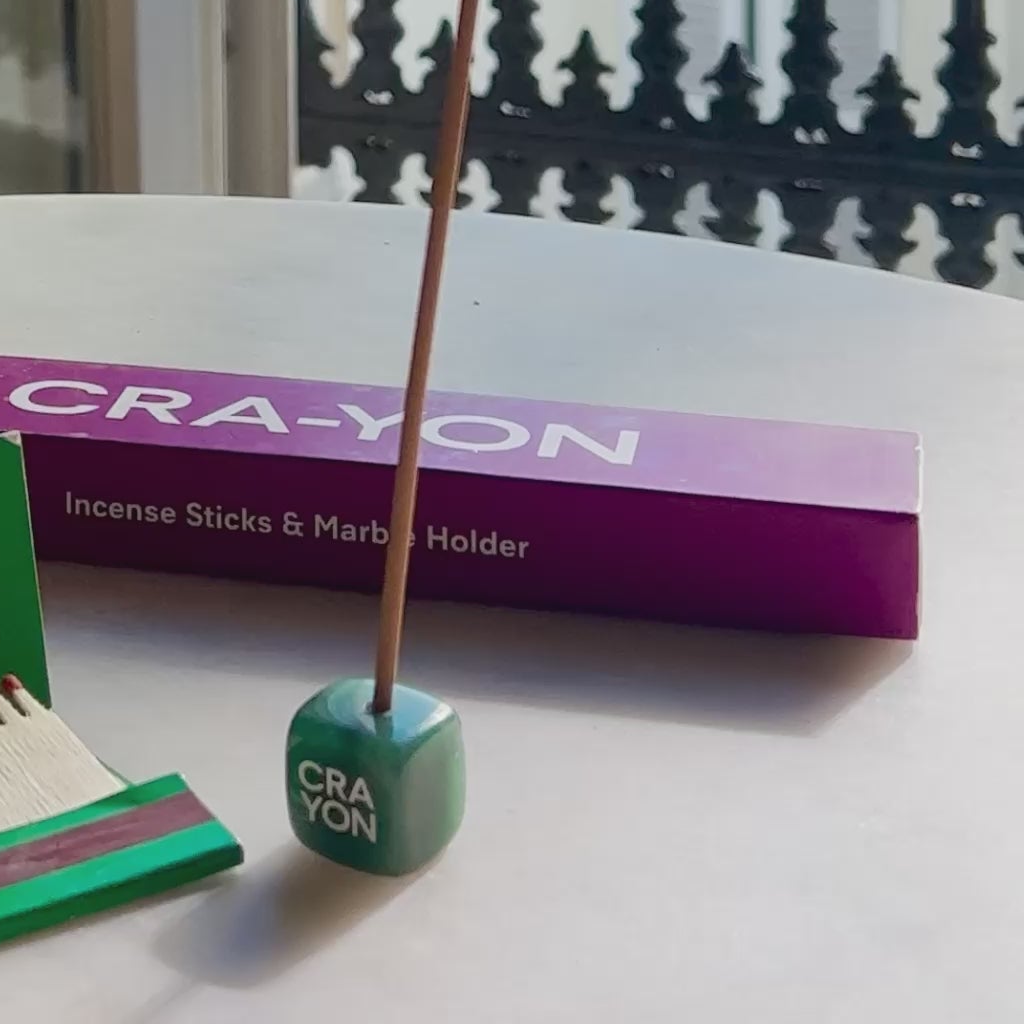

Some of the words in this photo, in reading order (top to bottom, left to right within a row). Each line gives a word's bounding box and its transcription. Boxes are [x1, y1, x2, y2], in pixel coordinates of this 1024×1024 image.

[8, 380, 639, 465] CRA-YON
[65, 490, 177, 524] Incense
[186, 501, 273, 534] Sticks
[282, 511, 305, 537] &
[427, 525, 530, 559] Holder
[299, 760, 374, 809] CRA
[301, 790, 376, 843] YON
